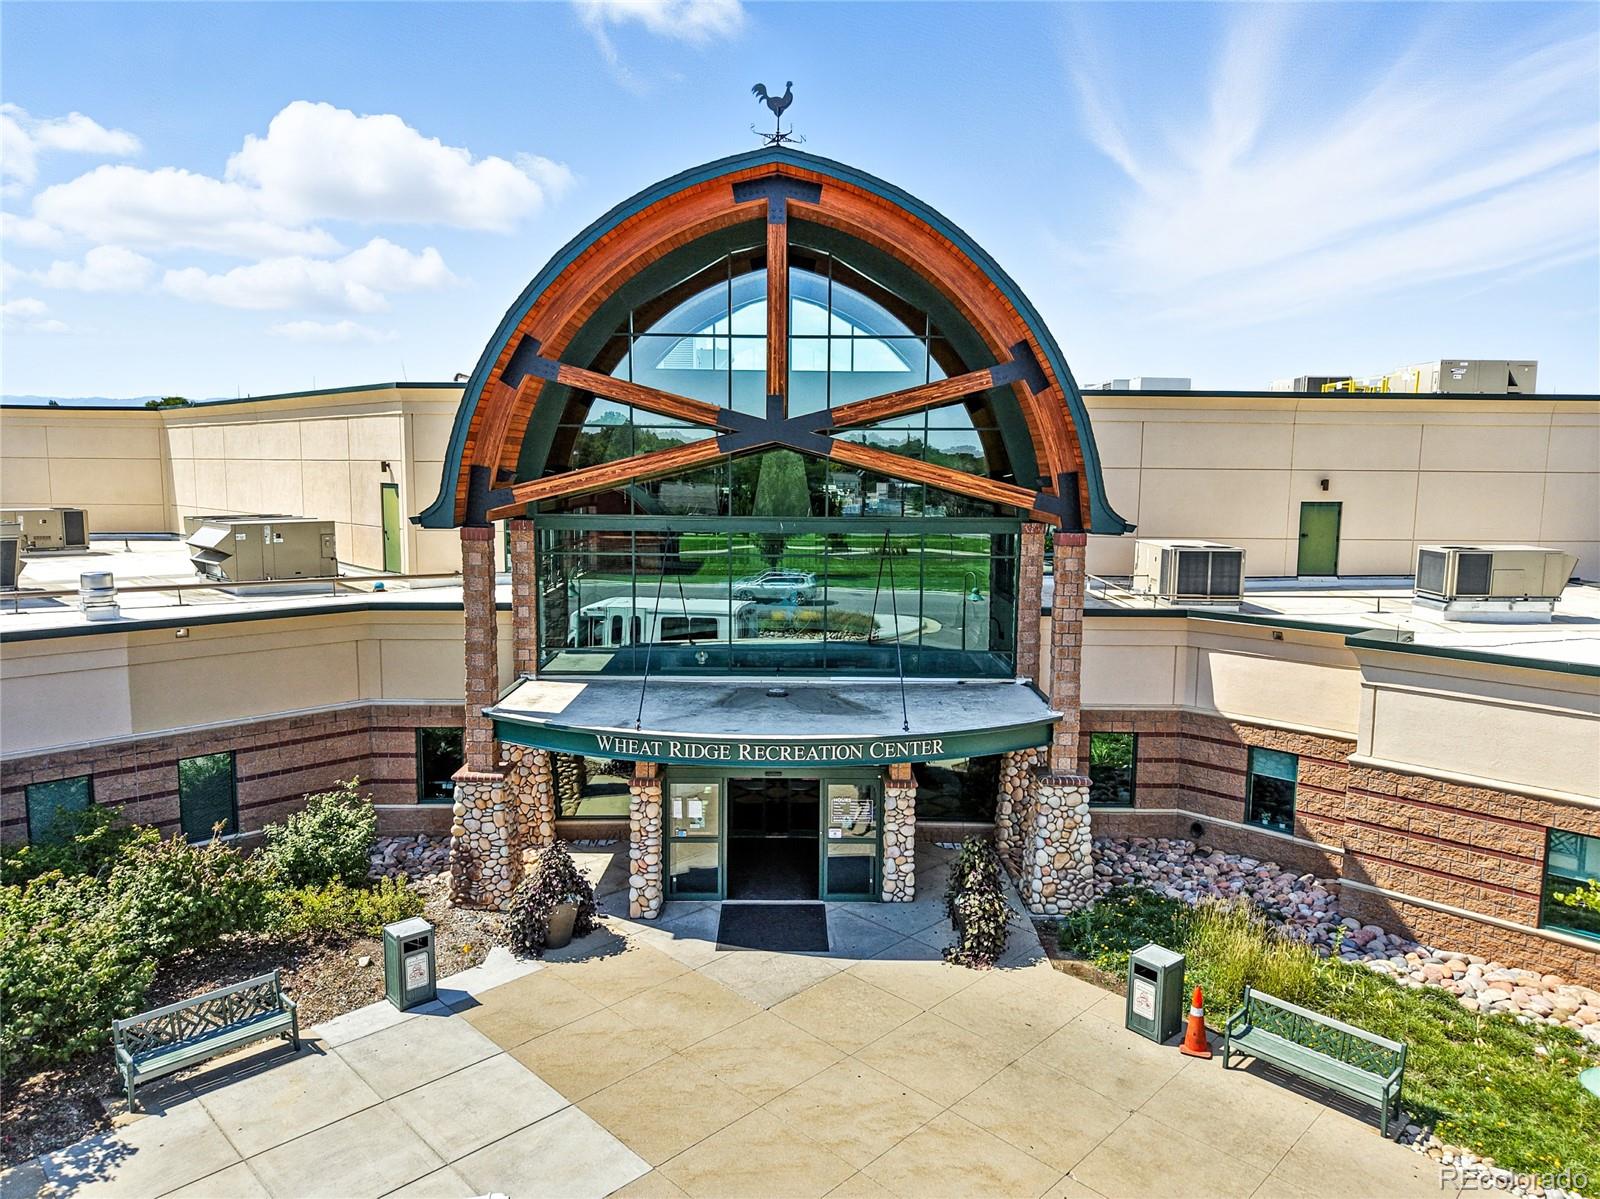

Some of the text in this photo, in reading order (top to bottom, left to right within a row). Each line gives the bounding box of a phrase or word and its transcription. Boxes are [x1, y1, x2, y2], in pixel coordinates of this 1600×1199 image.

[595, 734, 945, 761] WHEAT RIDGE RECREATION CENTER
